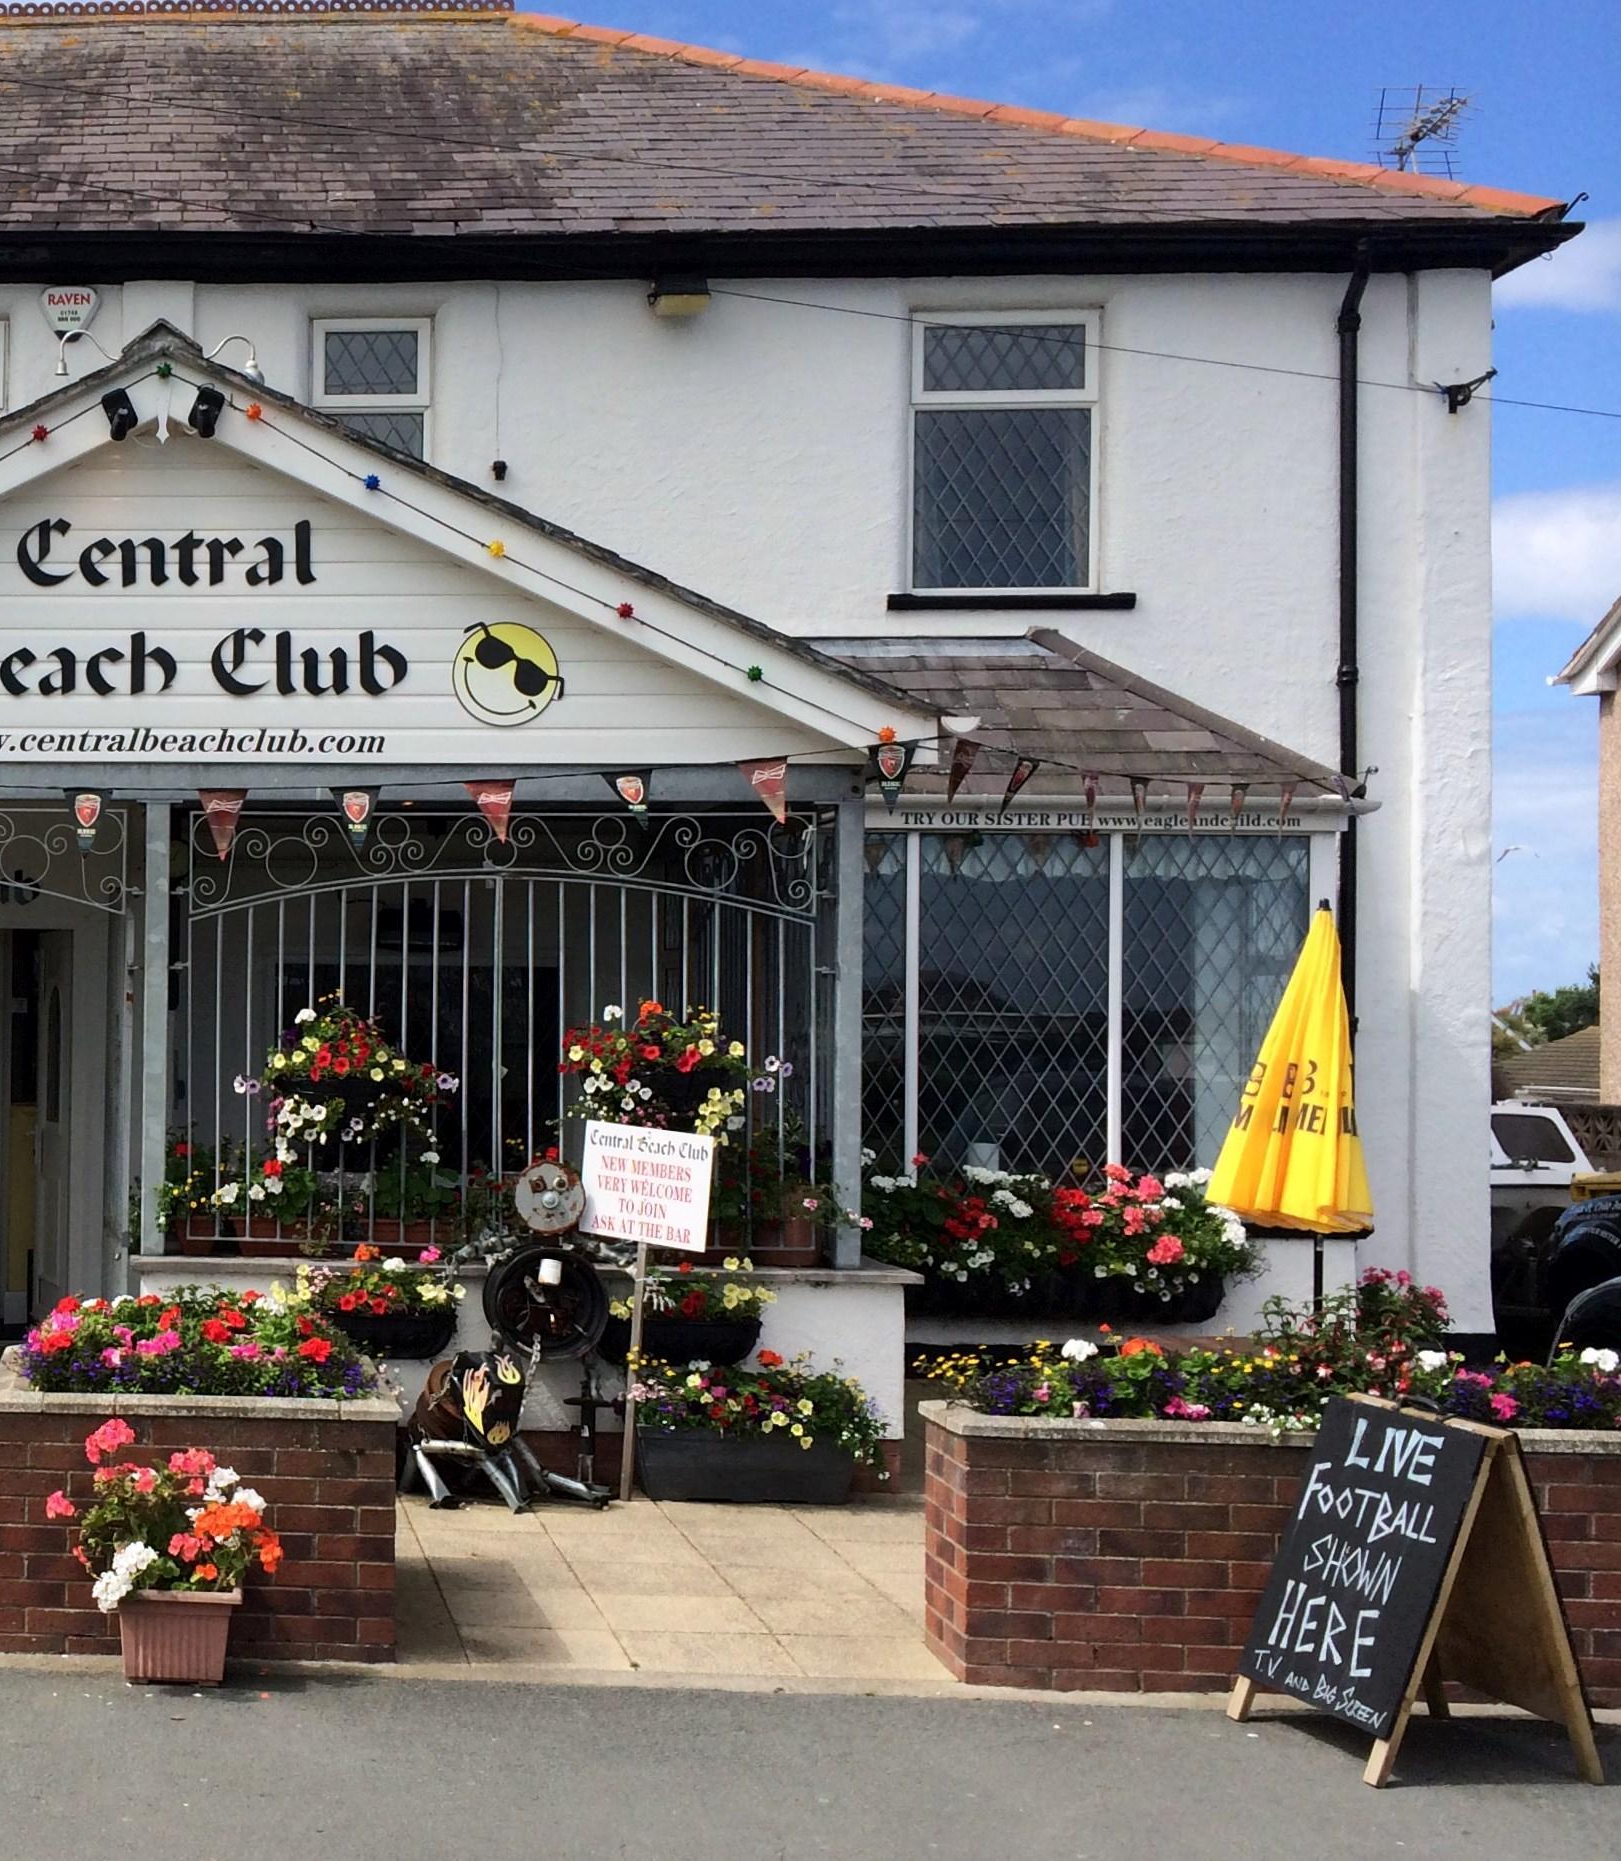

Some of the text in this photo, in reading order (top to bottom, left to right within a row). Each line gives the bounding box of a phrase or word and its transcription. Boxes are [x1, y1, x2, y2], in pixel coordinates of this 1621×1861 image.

[47, 293, 91, 305] RAVEN
[17, 518, 317, 587] Central
[211, 628, 408, 696] Club
[901, 812, 935, 826] TRY
[941, 812, 979, 826] OUR
[984, 812, 1050, 826] SISTER
[590, 1129, 708, 1161] Central Beach Club
[598, 1175, 692, 1203] VERY WELCOME
[601, 1155, 692, 1182] NEW MEMBERS
[591, 1215, 691, 1244] ASK AT THE BAR
[619, 1199, 667, 1219] TO JOIN
[1344, 1417, 1445, 1486] LIVE
[1298, 1462, 1436, 1544] FOOTBALL
[1303, 1534, 1402, 1606] SHOWN
[1268, 1579, 1380, 1677] HERE
[1284, 1671, 1310, 1692] AND
[1312, 1673, 1337, 1704] BIG
[1334, 1686, 1387, 1729] SCREEN
